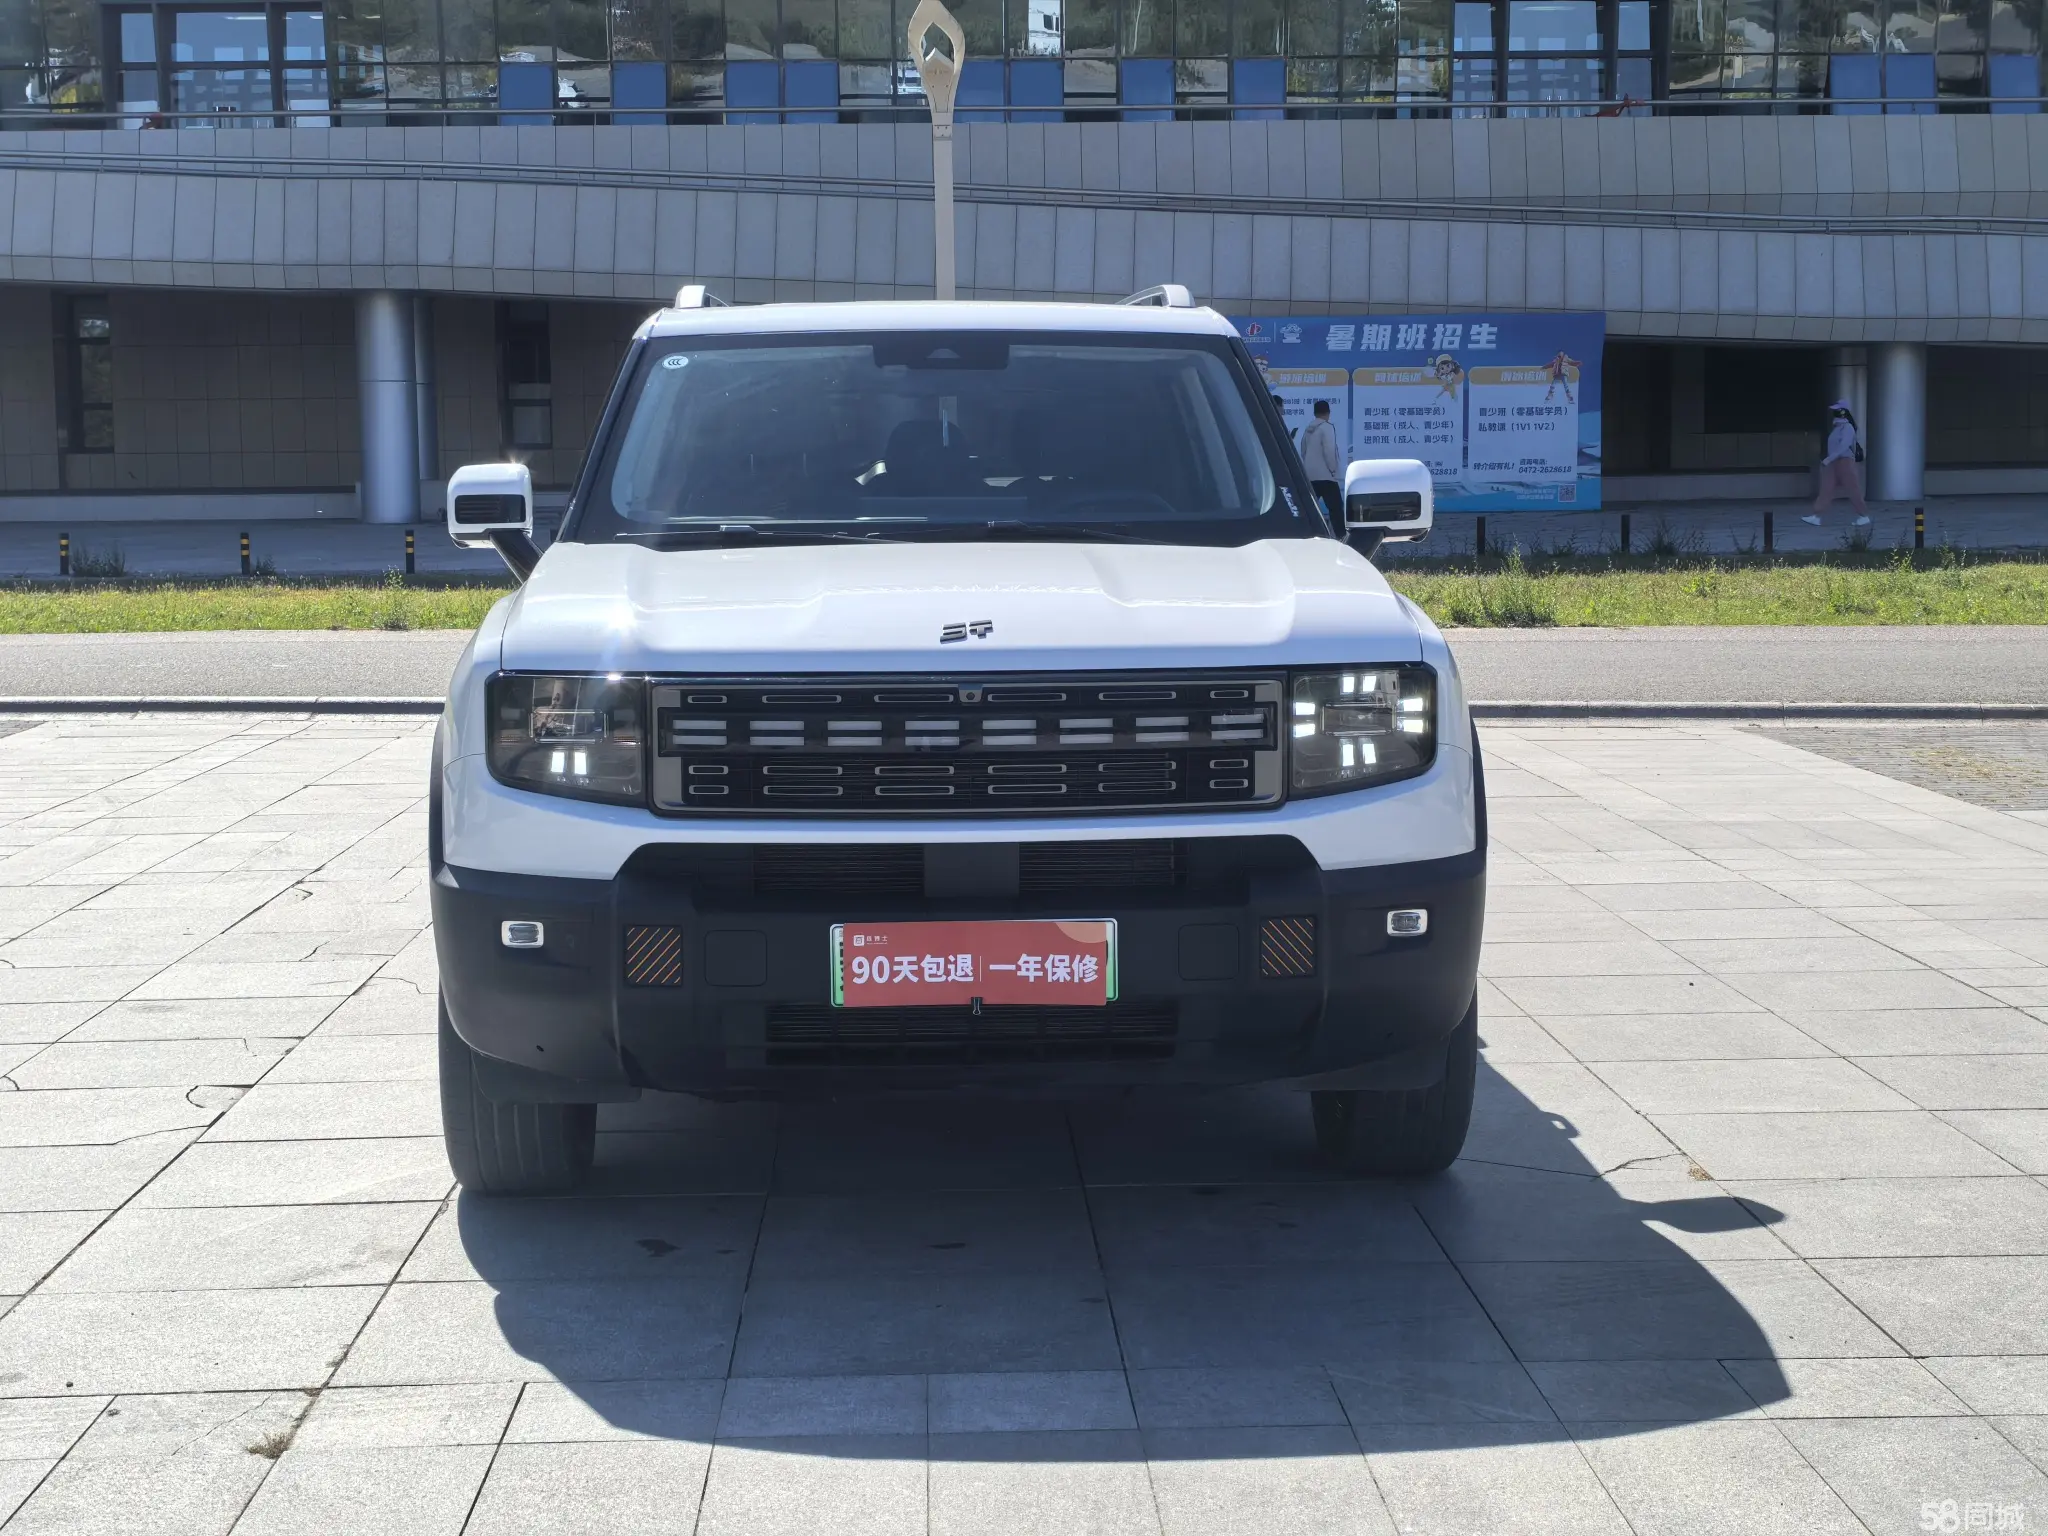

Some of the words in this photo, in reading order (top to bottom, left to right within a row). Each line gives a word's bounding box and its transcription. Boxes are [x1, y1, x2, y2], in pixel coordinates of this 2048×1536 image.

[1326, 323, 1498, 351] 暑期班招生
[851, 953, 974, 984] 90天包退
[989, 953, 1099, 983] 一年保修
